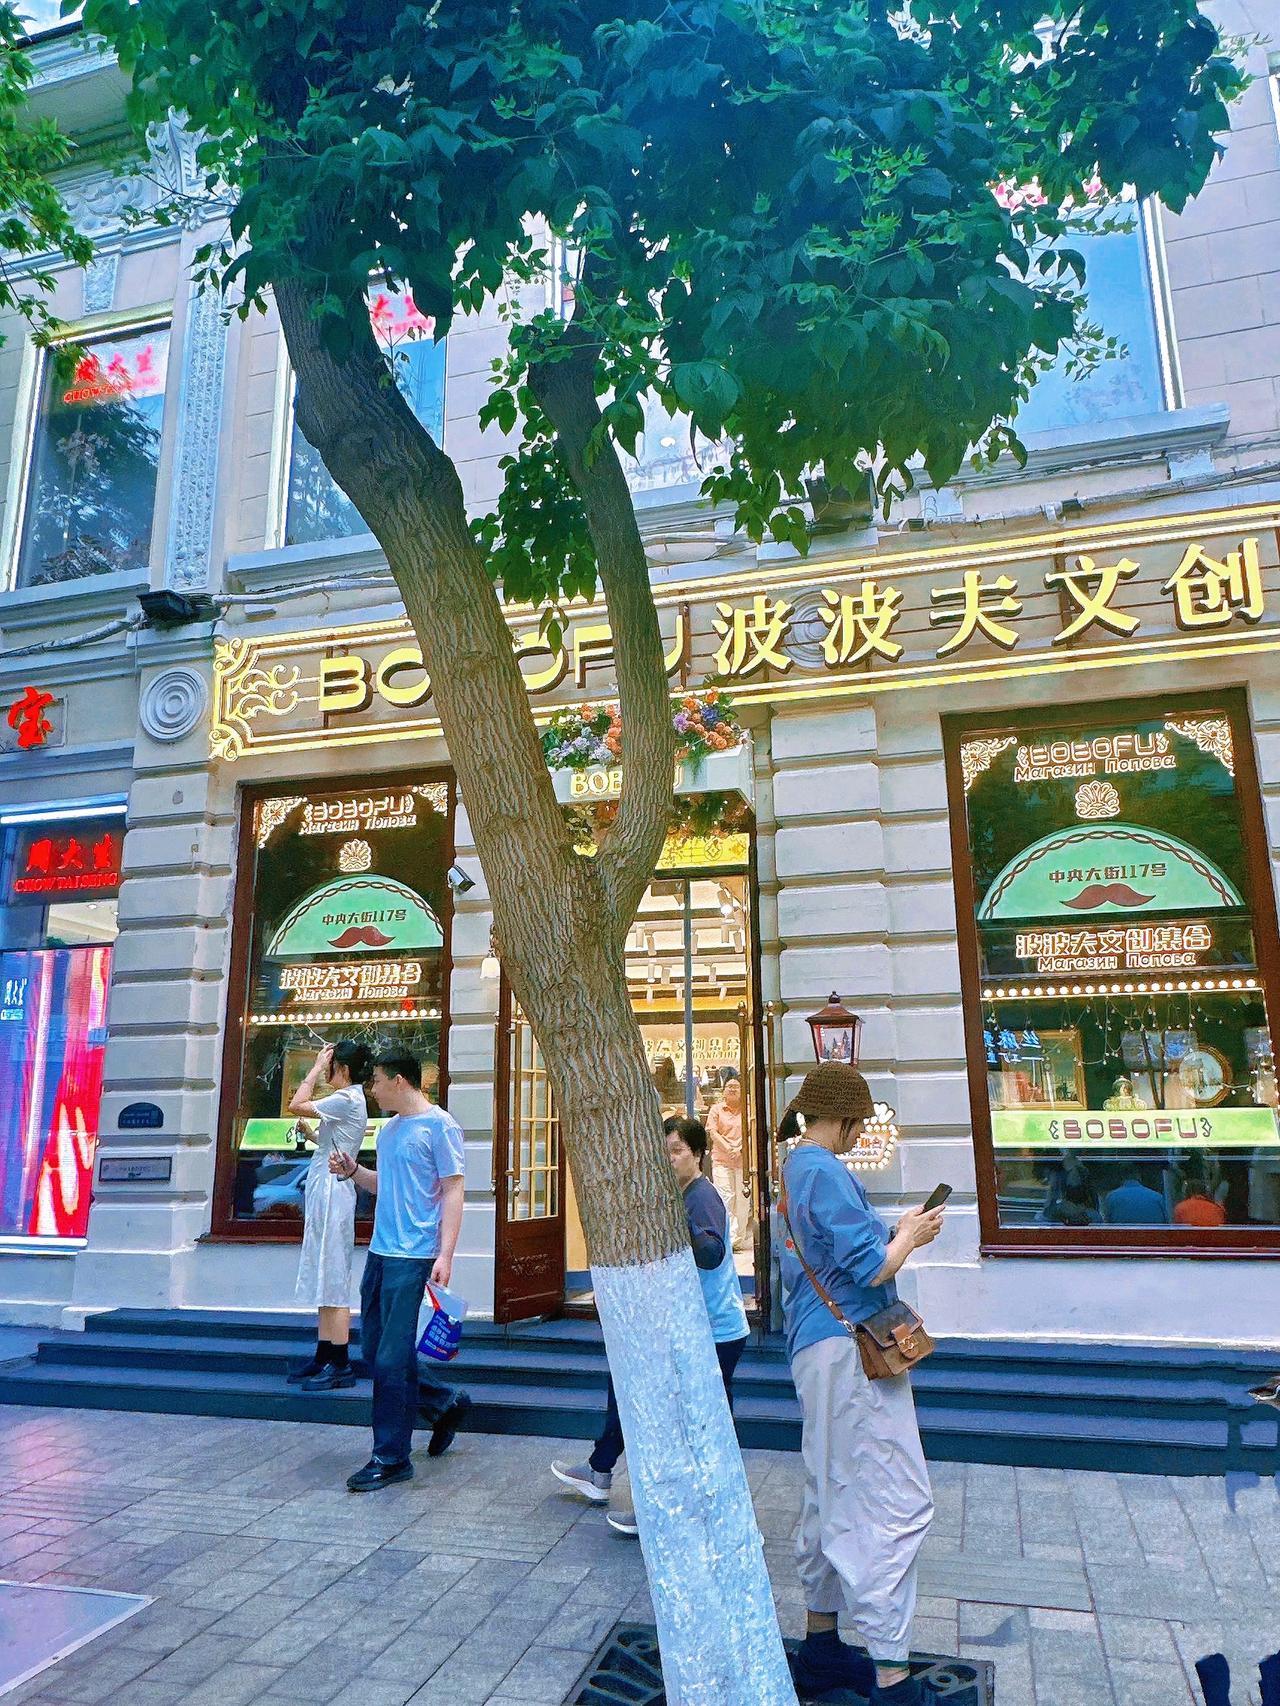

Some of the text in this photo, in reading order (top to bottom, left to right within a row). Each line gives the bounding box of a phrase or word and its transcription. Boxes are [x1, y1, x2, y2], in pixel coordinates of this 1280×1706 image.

[319, 538, 1265, 712] BOOF 波波夫文创
[1031, 733, 1156, 765] BOBOFU
[1014, 754, 1176, 782] Магазин Попова
[1049, 863, 1167, 883] 中央大街117号
[322, 909, 407, 925] 中央大街117号
[1016, 925, 1212, 958] 波波夫文创集合
[1038, 952, 1196, 972] Магазин Попова
[1063, 1117, 1198, 1140] BOBOFU
